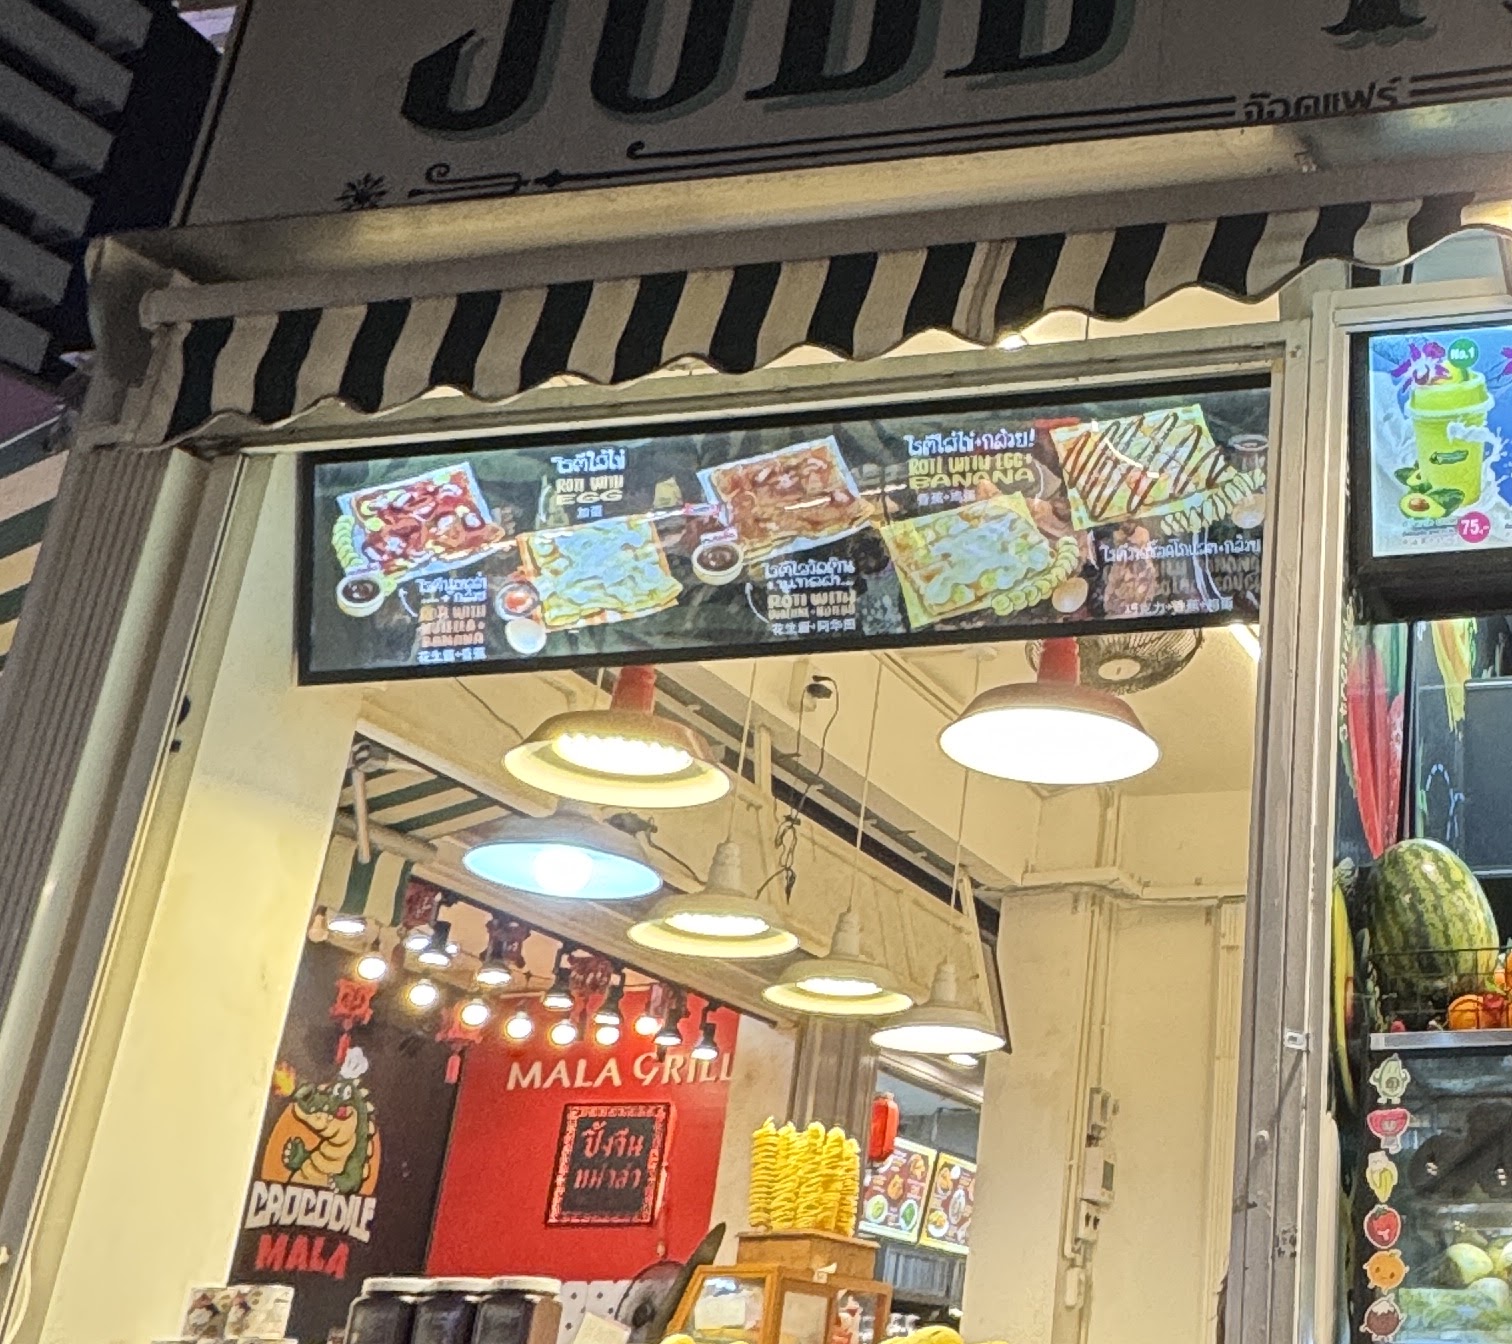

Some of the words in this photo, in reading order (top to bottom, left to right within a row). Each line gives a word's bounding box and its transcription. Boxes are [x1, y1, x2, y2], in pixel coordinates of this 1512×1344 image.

[1450, 347, 1475, 360] No.1
[909, 468, 1036, 490] BANANA
[556, 489, 624, 506] EGG
[506, 1058, 622, 1091] MALA
[633, 1051, 732, 1086] GRILL
[245, 1180, 377, 1244] CROCODILE
[255, 1232, 350, 1280] MALA
